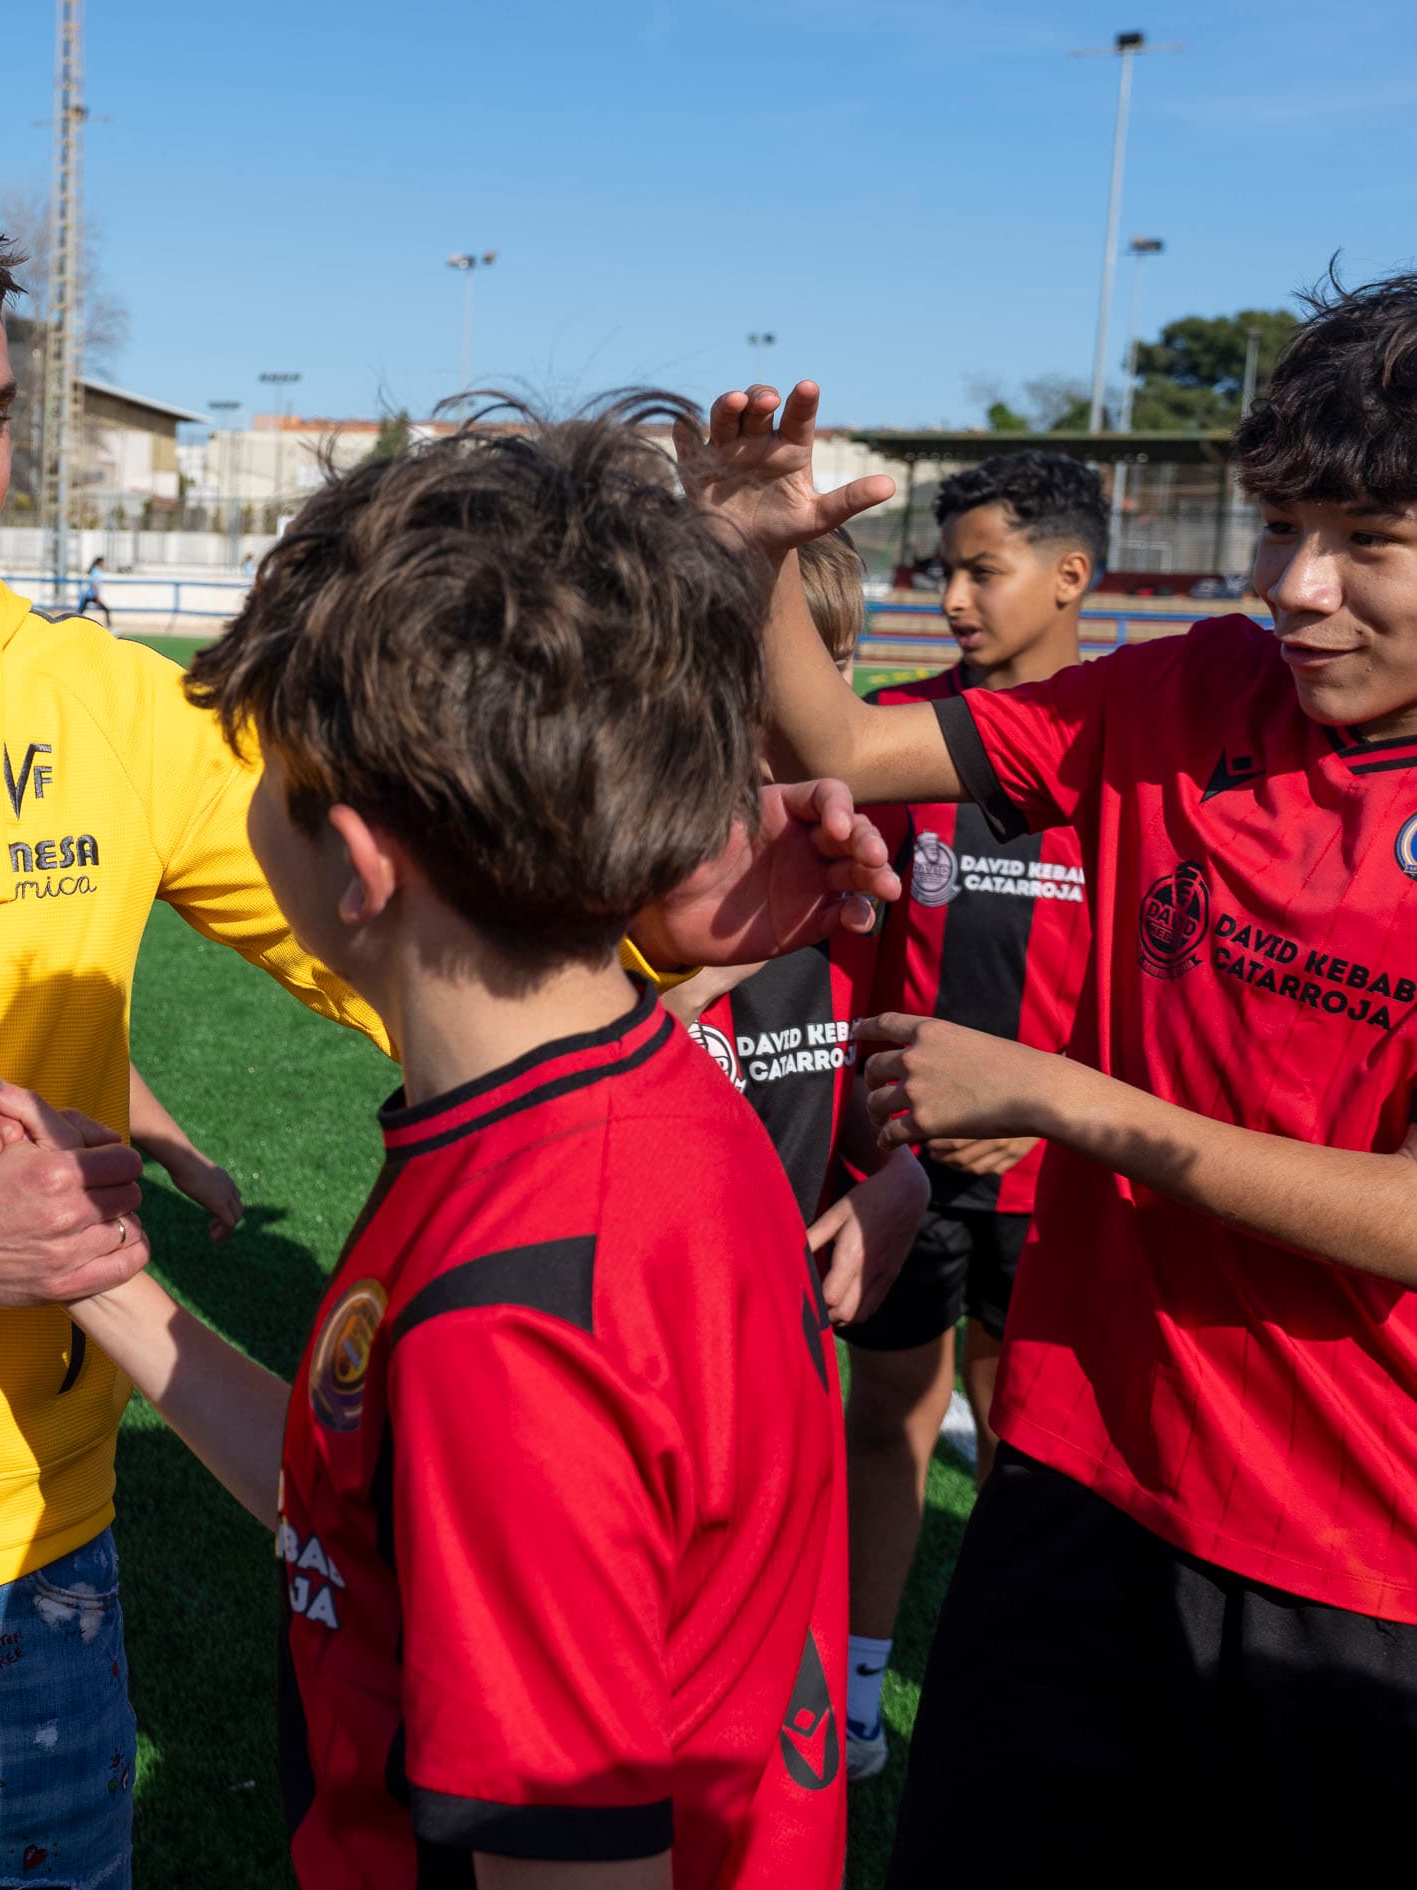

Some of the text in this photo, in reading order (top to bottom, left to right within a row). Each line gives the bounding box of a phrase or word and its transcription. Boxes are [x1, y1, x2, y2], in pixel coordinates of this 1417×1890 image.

[960, 855, 1024, 877] DAVID
[965, 874, 1084, 903] CATARROJA
[1213, 913, 1417, 1003] DAVID KEBAB
[1213, 948, 1391, 1031] CATARROJA
[736, 1027, 802, 1057] DAVID
